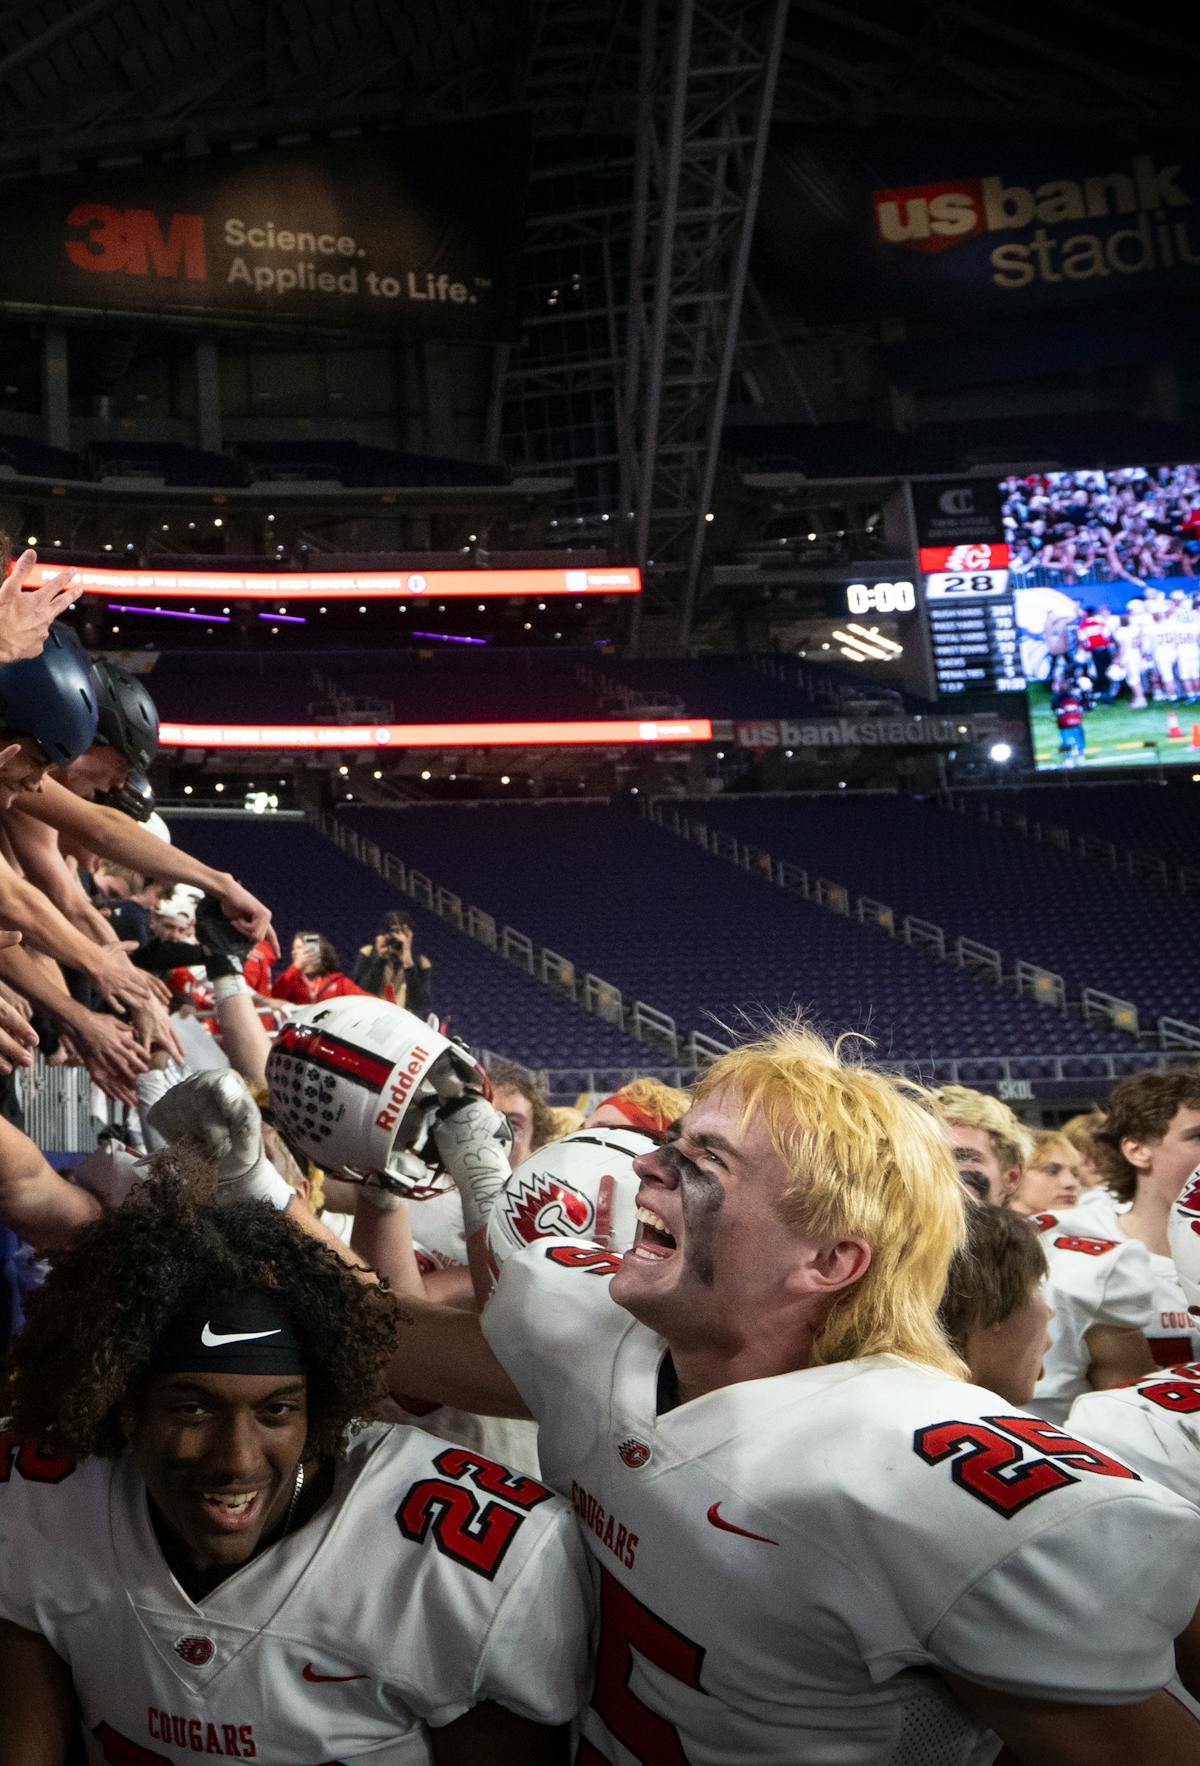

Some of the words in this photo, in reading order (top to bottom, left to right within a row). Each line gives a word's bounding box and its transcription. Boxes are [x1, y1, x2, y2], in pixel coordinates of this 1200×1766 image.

[65, 203, 206, 280] 3M
[224, 219, 366, 257] Science.
[228, 257, 358, 296] Applied
[366, 271, 399, 297] to
[846, 581, 916, 614] 0:00
[943, 575, 994, 593] 28
[375, 1045, 430, 1133] Riddell
[913, 1415, 1144, 1520] 25
[395, 1448, 556, 1583] 22
[571, 1480, 640, 1570] COUGARS
[147, 1706, 257, 1758] COUGARS
